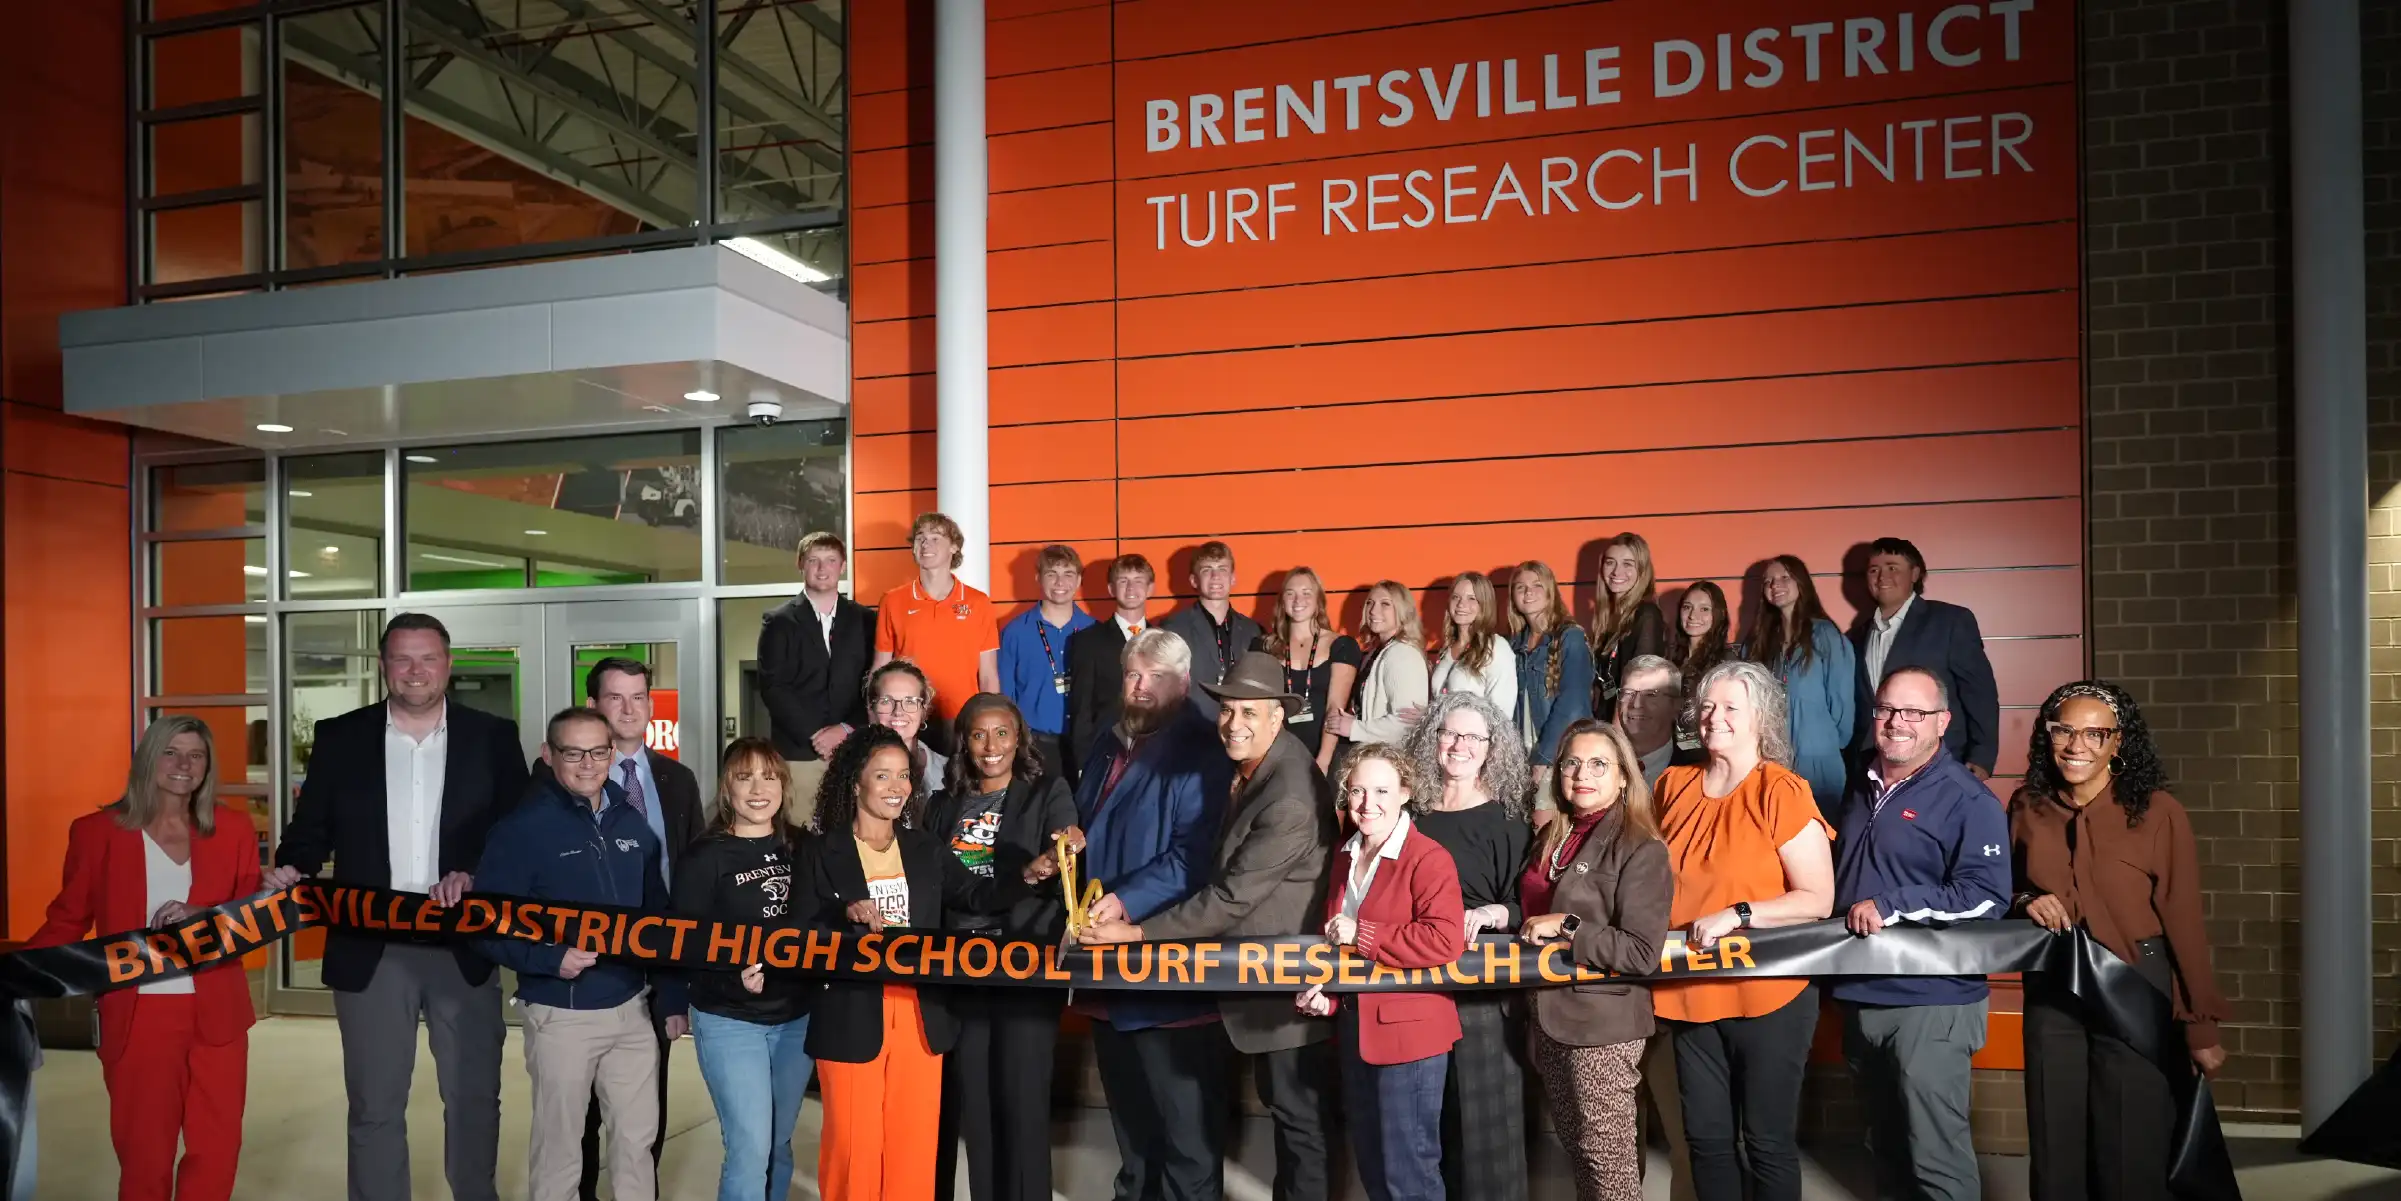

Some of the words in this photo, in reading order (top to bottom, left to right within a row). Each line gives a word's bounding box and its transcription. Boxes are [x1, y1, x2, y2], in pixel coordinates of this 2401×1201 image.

[1146, 46, 1621, 153] BRENTSVILLE
[1653, 0, 2034, 98] DISTRICT
[1147, 182, 1297, 250] TURF
[1322, 143, 1697, 236] RESEARCH
[1729, 112, 2034, 197] CENTER
[104, 884, 445, 983] BRENTSVILLE
[455, 899, 698, 961] DISTRICT
[707, 922, 842, 971] HIGH
[852, 934, 1070, 981] SCHOOL
[1082, 942, 1222, 983] TURF
[1537, 936, 1756, 982] CTER
